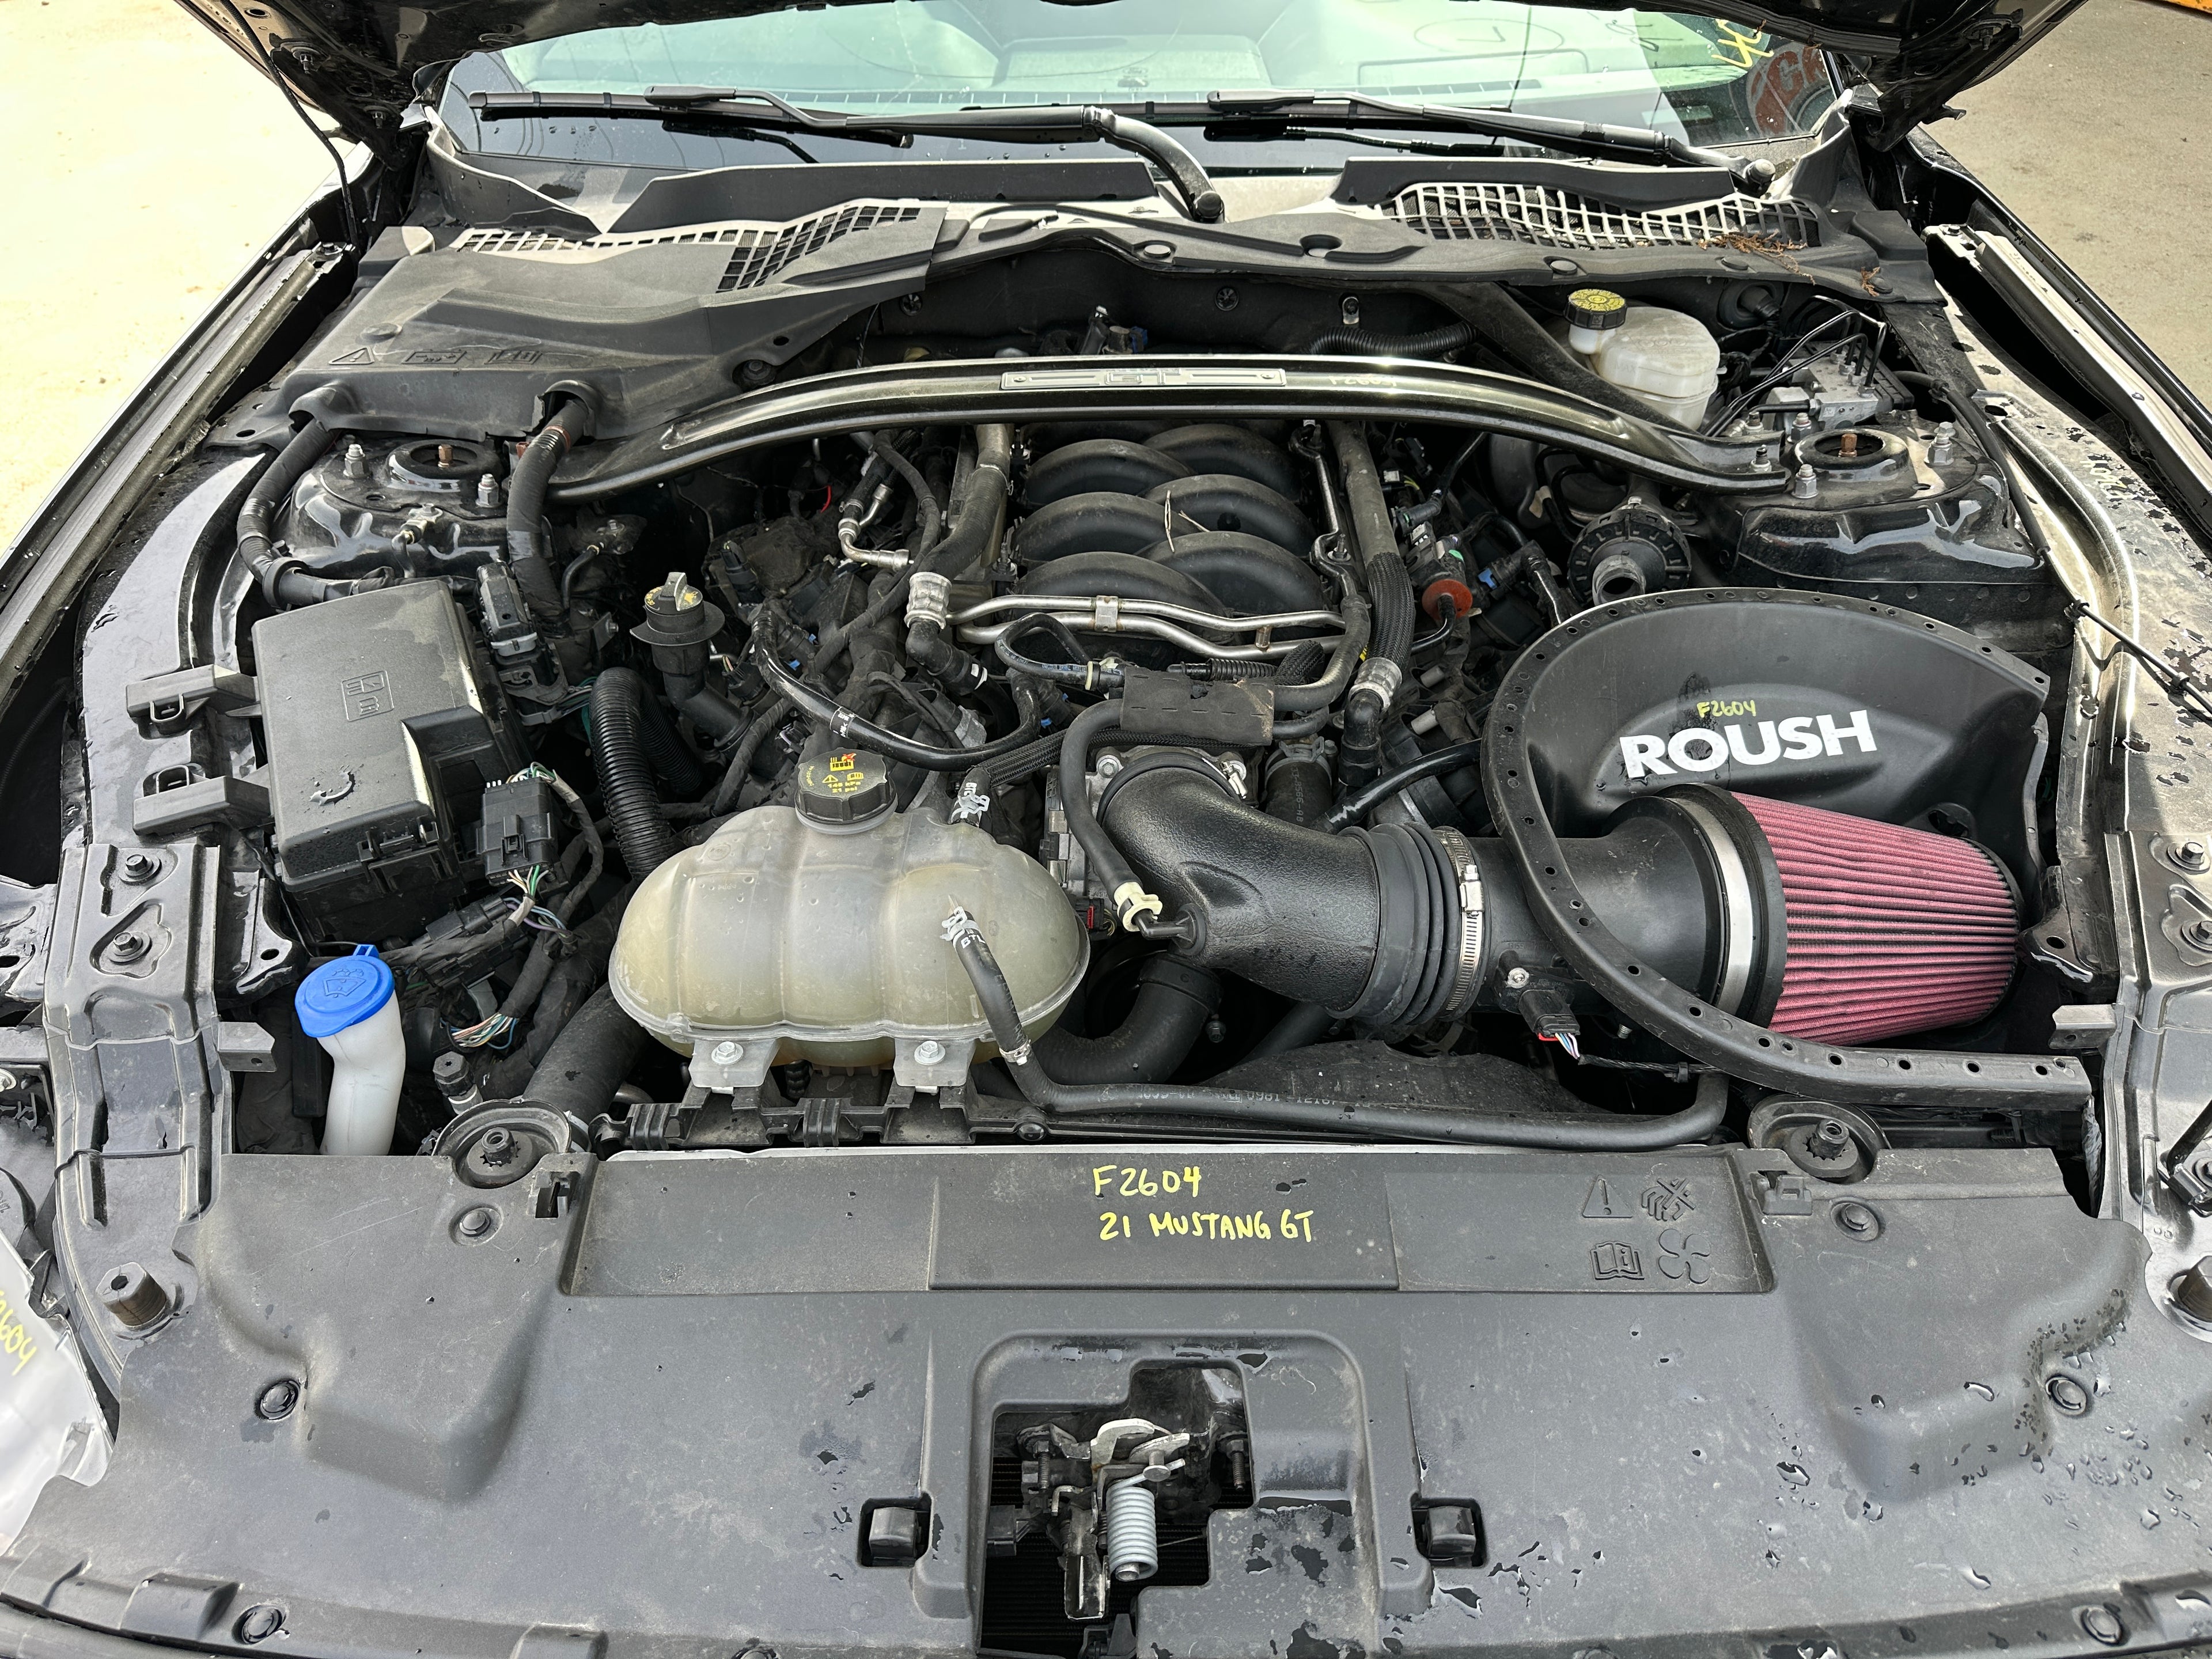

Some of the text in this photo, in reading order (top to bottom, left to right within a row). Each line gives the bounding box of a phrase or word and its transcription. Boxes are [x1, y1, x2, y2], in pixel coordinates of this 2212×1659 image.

[1696, 699, 1756, 718] F2604
[1619, 709, 1877, 778] ROUSH
[1093, 1165, 1202, 1197] F2604
[1099, 1209, 1314, 1243] 21 MUSTANG GT
